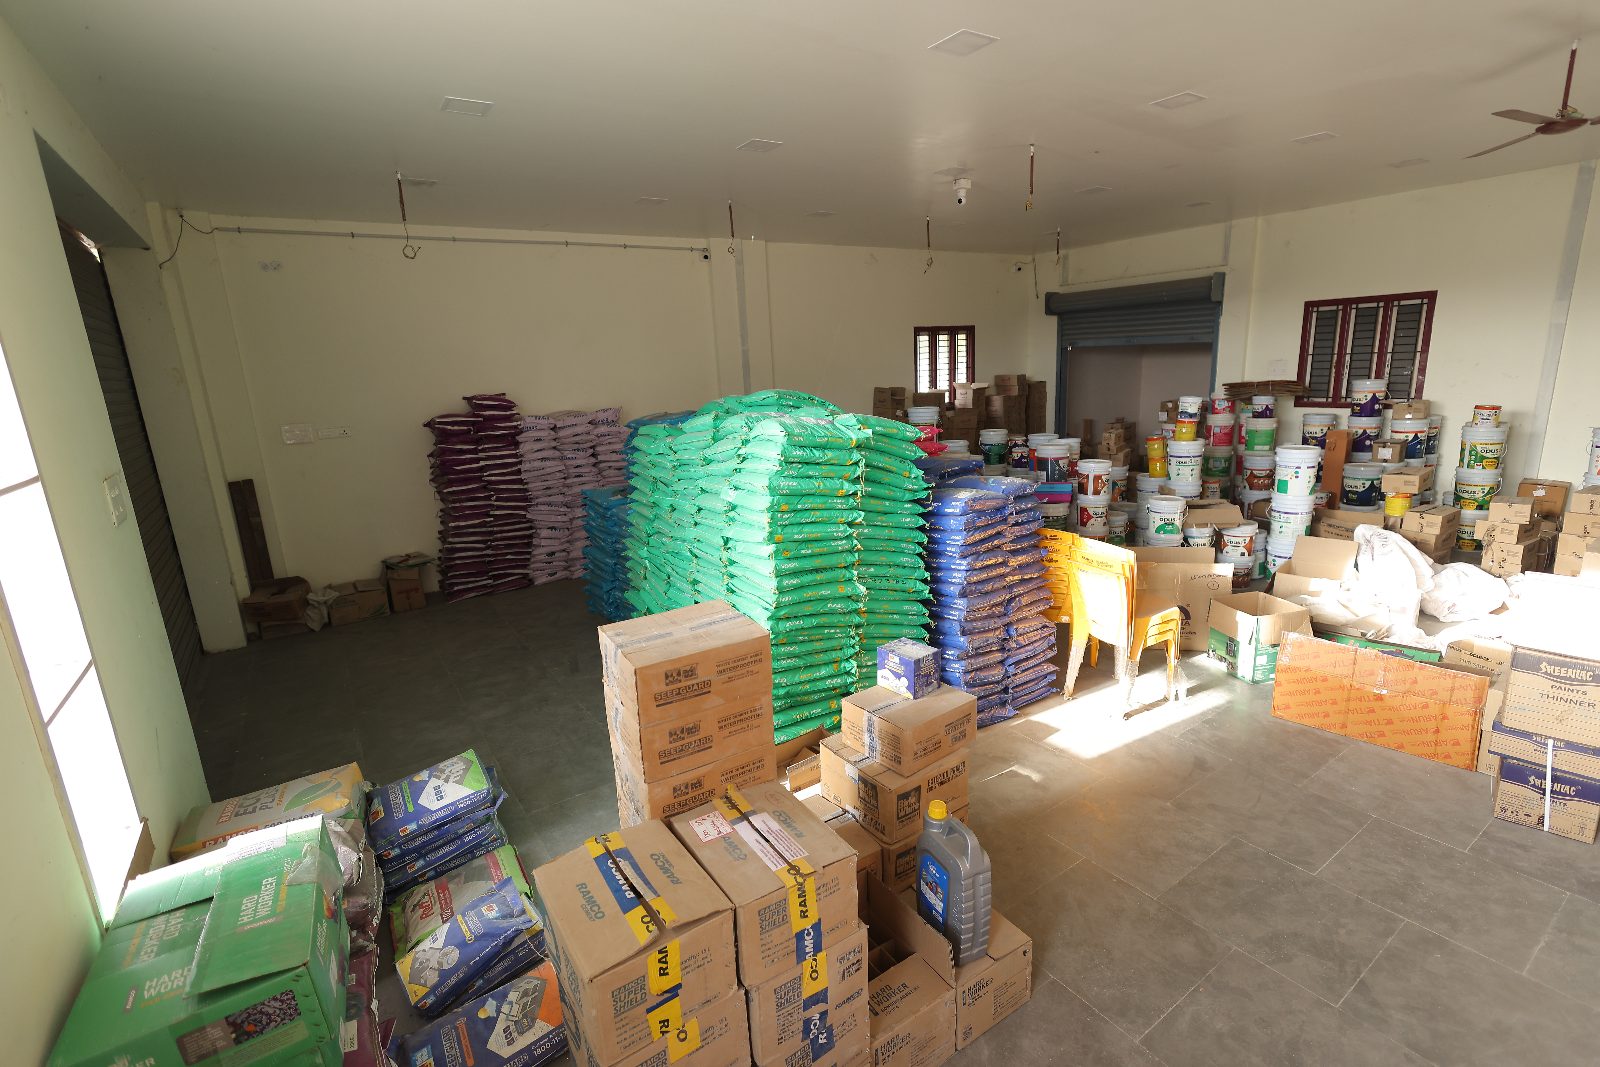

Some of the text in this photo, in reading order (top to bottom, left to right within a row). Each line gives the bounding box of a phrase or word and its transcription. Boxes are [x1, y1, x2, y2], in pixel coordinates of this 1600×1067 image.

[1539, 692, 1596, 709] THINNER
[1550, 684, 1588, 696] PAINTS
[255, 876, 278, 919] WORKER
[576, 882, 606, 920] RAMCO
[758, 898, 787, 917] RAMCO
[238, 894, 258, 924] HARD
[759, 906, 787, 923] SUPER
[760, 914, 788, 933] SHIELD
[612, 975, 646, 998] RAMCO
[612, 985, 646, 1007] SUPER
[872, 982, 910, 1008] WORKER
[614, 992, 648, 1016] SHIELD
[776, 992, 802, 1010] SHIELD
